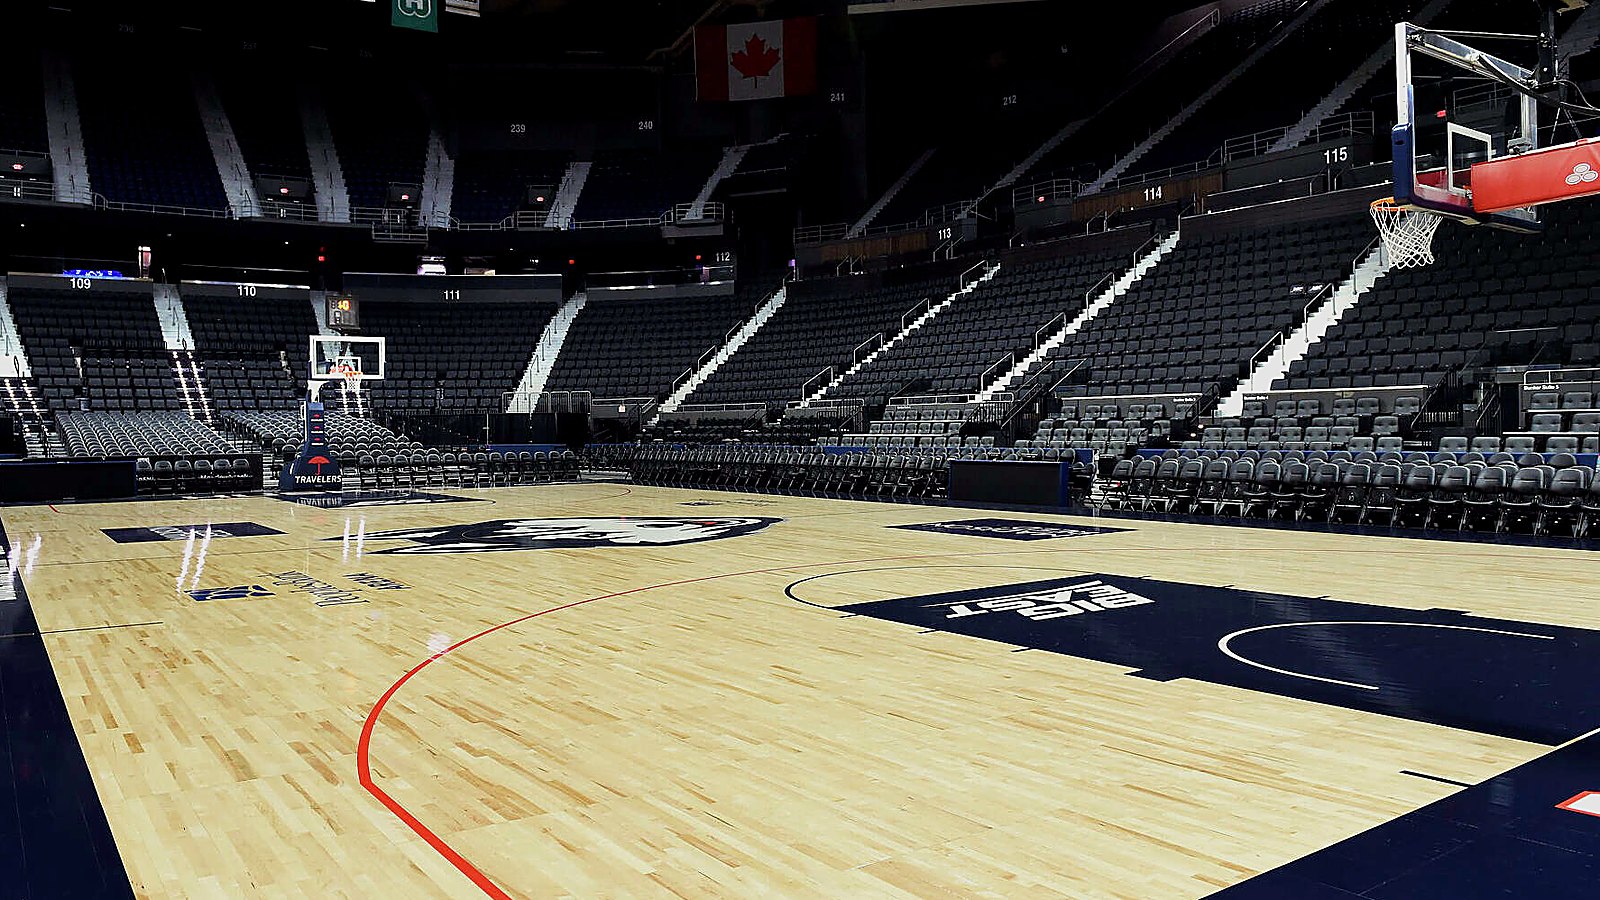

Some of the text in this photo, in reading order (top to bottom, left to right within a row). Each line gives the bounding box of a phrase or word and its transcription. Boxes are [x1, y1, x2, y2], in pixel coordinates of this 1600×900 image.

[830, 93, 845, 102] 241
[1003, 95, 1017, 106] 212
[510, 124, 526, 133] 239
[638, 121, 653, 130] 240
[1323, 146, 1348, 164] 115
[1143, 185, 1162, 201] 114
[938, 227, 951, 240] 113
[715, 251, 730, 262] 112
[69, 278, 91, 289] 109
[237, 285, 257, 297] 110
[443, 289, 460, 300] 111
[295, 475, 342, 484] TRAVELERS
[945, 584, 1128, 619] EAST
[1016, 592, 1156, 621] BIG
